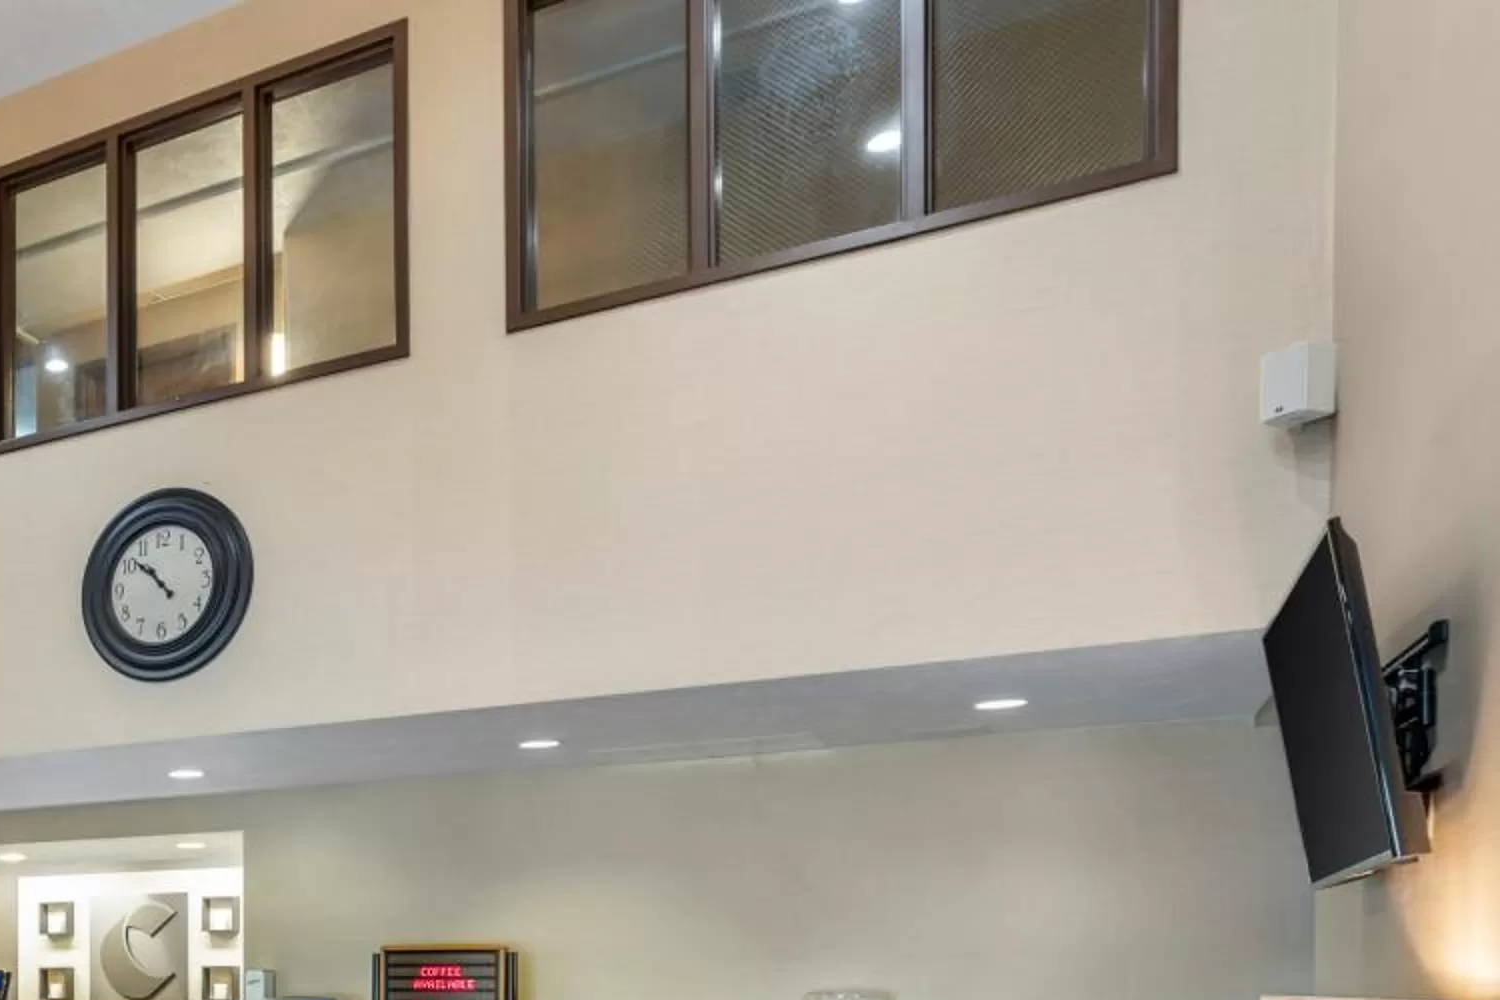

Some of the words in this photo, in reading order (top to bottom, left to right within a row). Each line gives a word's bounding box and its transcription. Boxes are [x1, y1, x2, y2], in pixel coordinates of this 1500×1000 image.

[138, 538, 149, 557] 11
[155, 529, 171, 549] 12
[180, 534, 185, 551] 1
[194, 547, 205, 565] 2
[123, 558, 137, 576] 10
[200, 570, 211, 589] 3
[114, 583, 125, 600] 9
[192, 595, 202, 611] 4
[120, 605, 131, 621] 8
[177, 613, 188, 629] 5
[135, 617, 145, 636] 7
[156, 621, 167, 640] 6
[421, 967, 461, 977] COFFEE
[413, 979, 476, 989] AVAILABLE
